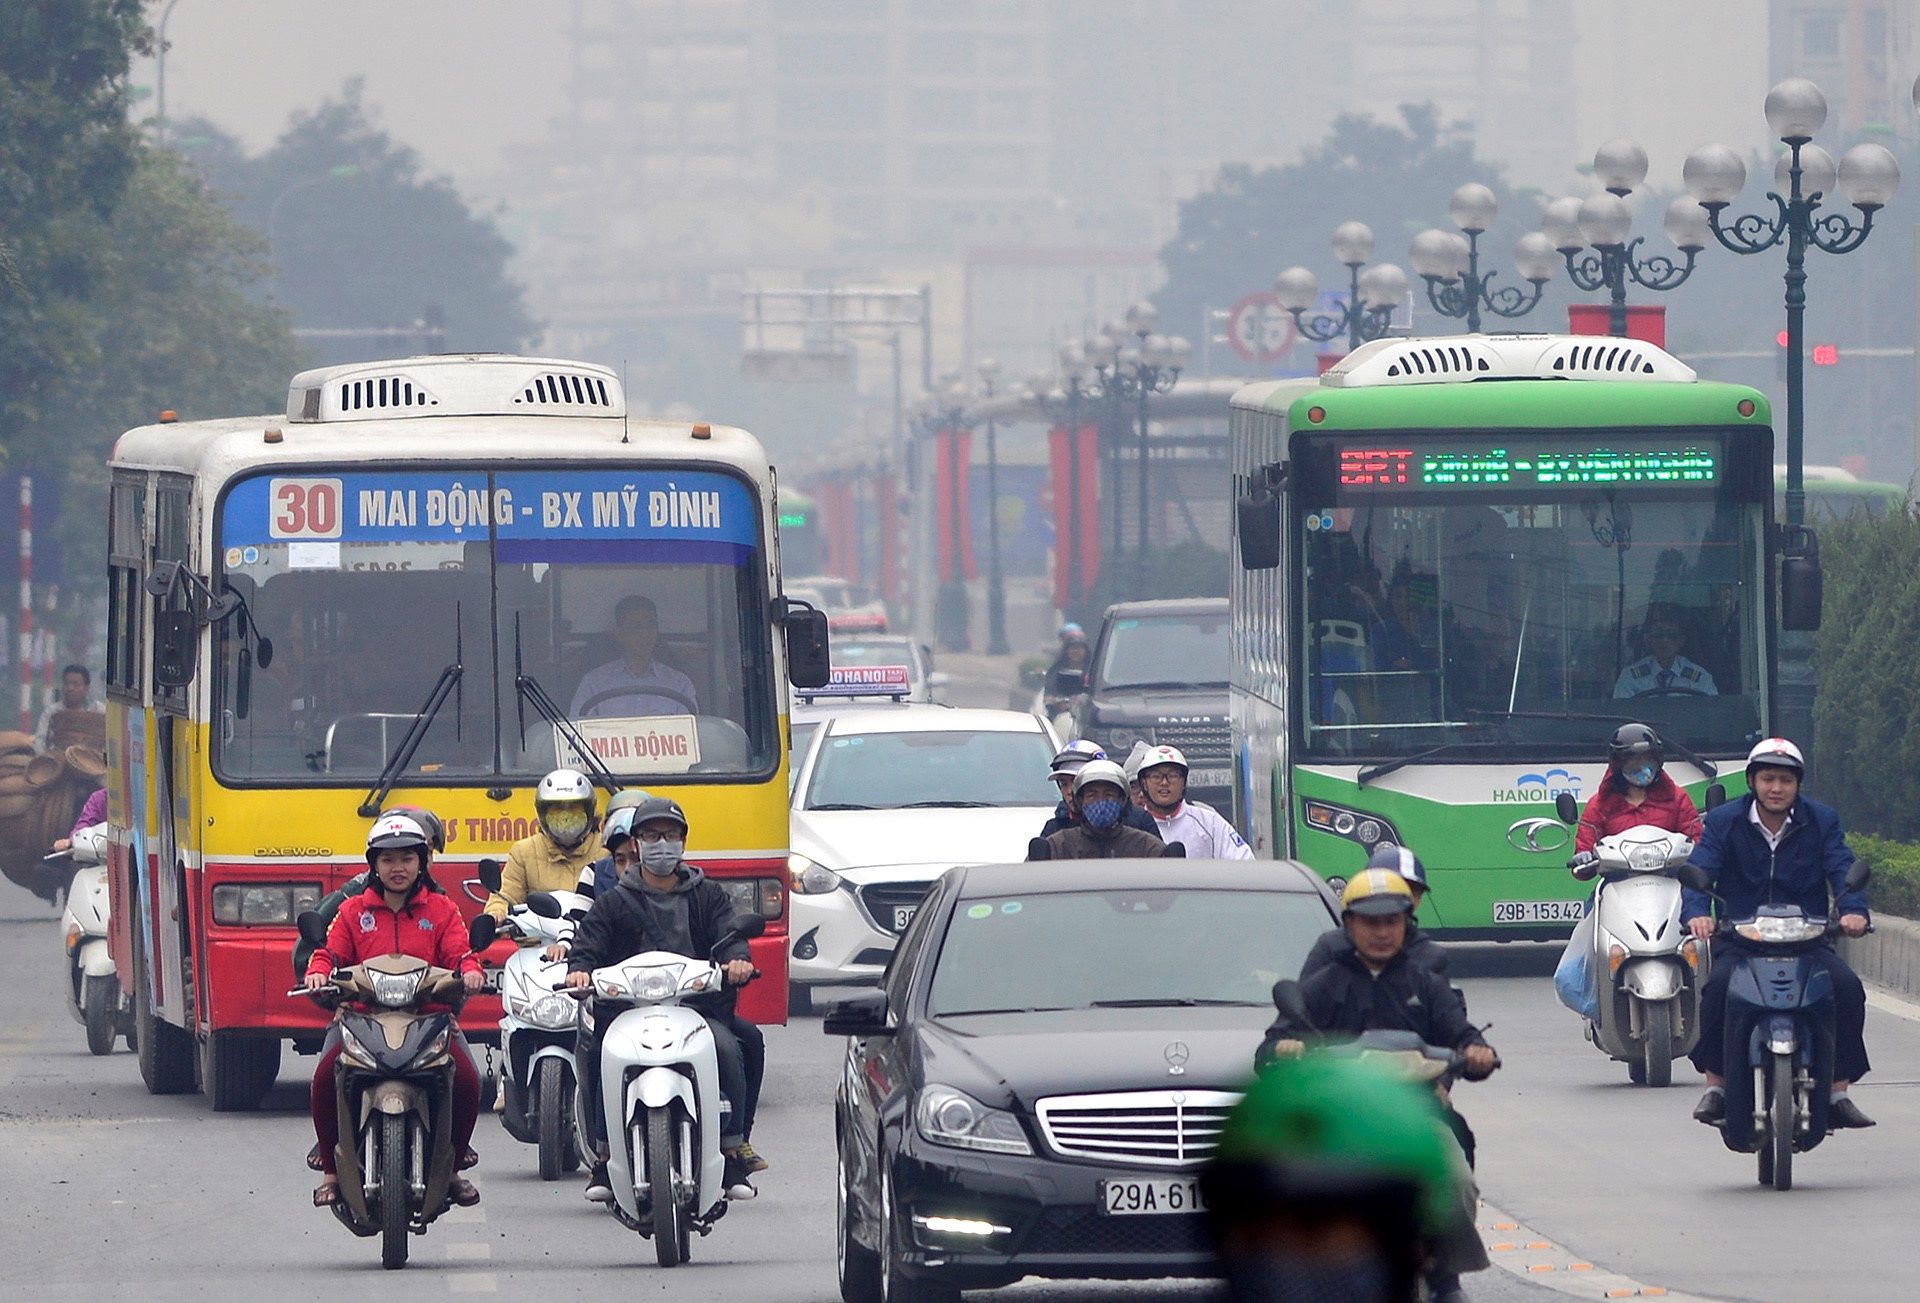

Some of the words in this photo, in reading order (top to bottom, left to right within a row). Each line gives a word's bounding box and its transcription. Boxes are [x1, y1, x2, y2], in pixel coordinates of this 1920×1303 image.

[1341, 451, 1413, 483] BRT
[277, 484, 336, 533] 30
[359, 490, 416, 527] MAI
[426, 482, 514, 533] ĐỘNG
[543, 491, 583, 528] BX
[592, 484, 639, 528] MỸ
[648, 482, 721, 528] ĐÌNH
[591, 736, 630, 758] MAI
[634, 730, 688, 761] ĐỘNG
[1493, 789, 1547, 802] HANOI
[254, 847, 334, 857] DAEWOO
[1495, 903, 1582, 921] 29B-153.42
[1110, 1183, 1206, 1210] 29A-61
